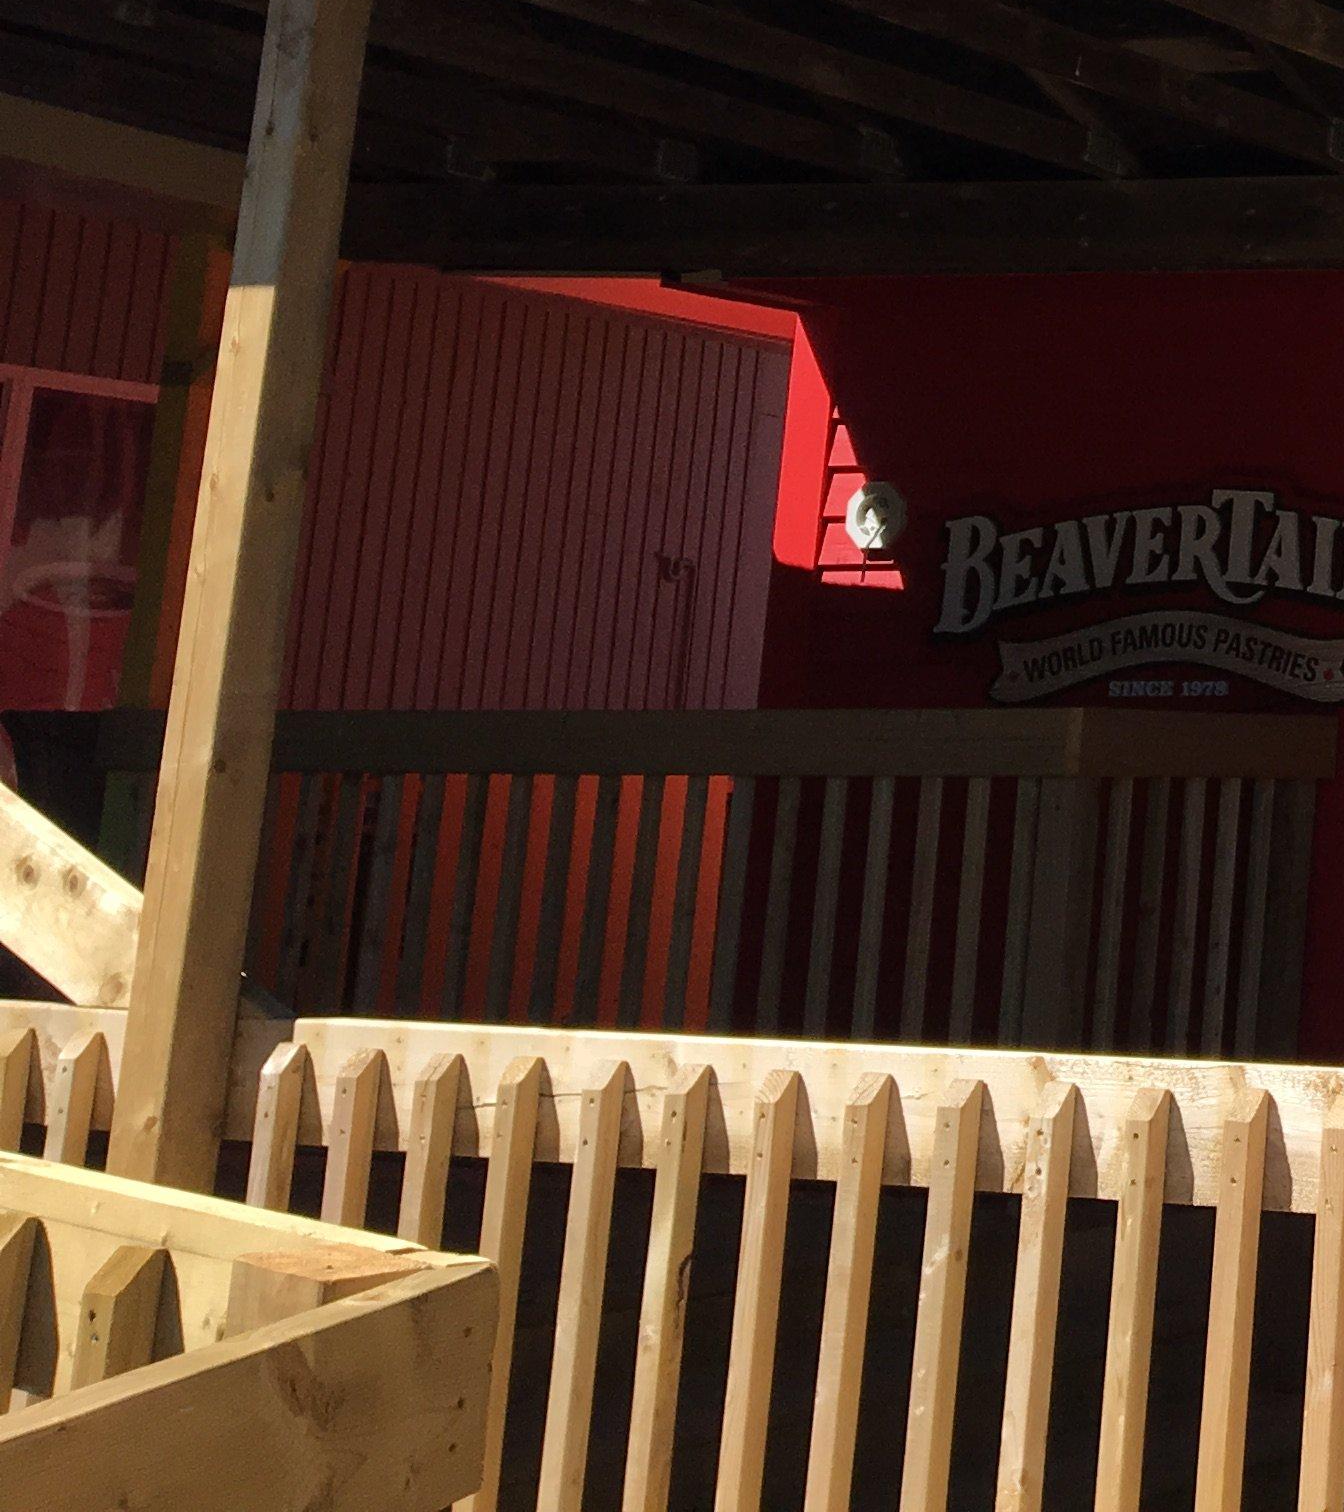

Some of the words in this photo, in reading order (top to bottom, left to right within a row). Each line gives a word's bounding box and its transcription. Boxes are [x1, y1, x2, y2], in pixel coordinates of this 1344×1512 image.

[1022, 640, 1102, 683] WORLD
[1109, 624, 1208, 656] FAMOUS
[1213, 627, 1320, 682] PASTRIES
[1108, 679, 1174, 697] SINCE
[1182, 679, 1229, 696] 1978
